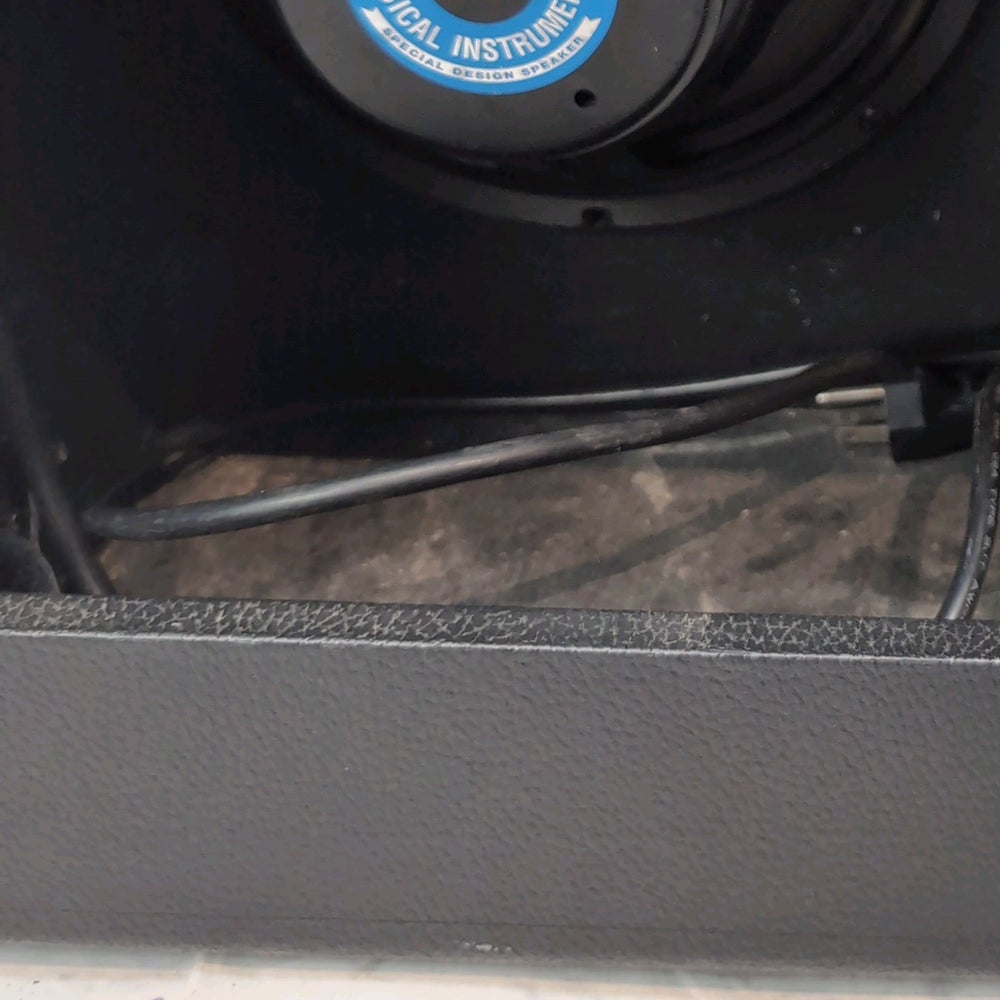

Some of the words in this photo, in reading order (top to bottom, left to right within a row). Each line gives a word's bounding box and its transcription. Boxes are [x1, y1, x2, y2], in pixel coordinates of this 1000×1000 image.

[381, 26, 445, 72] SPECIAL
[452, 65, 515, 81] DESIGN
[520, 34, 585, 77] SPEAKER
